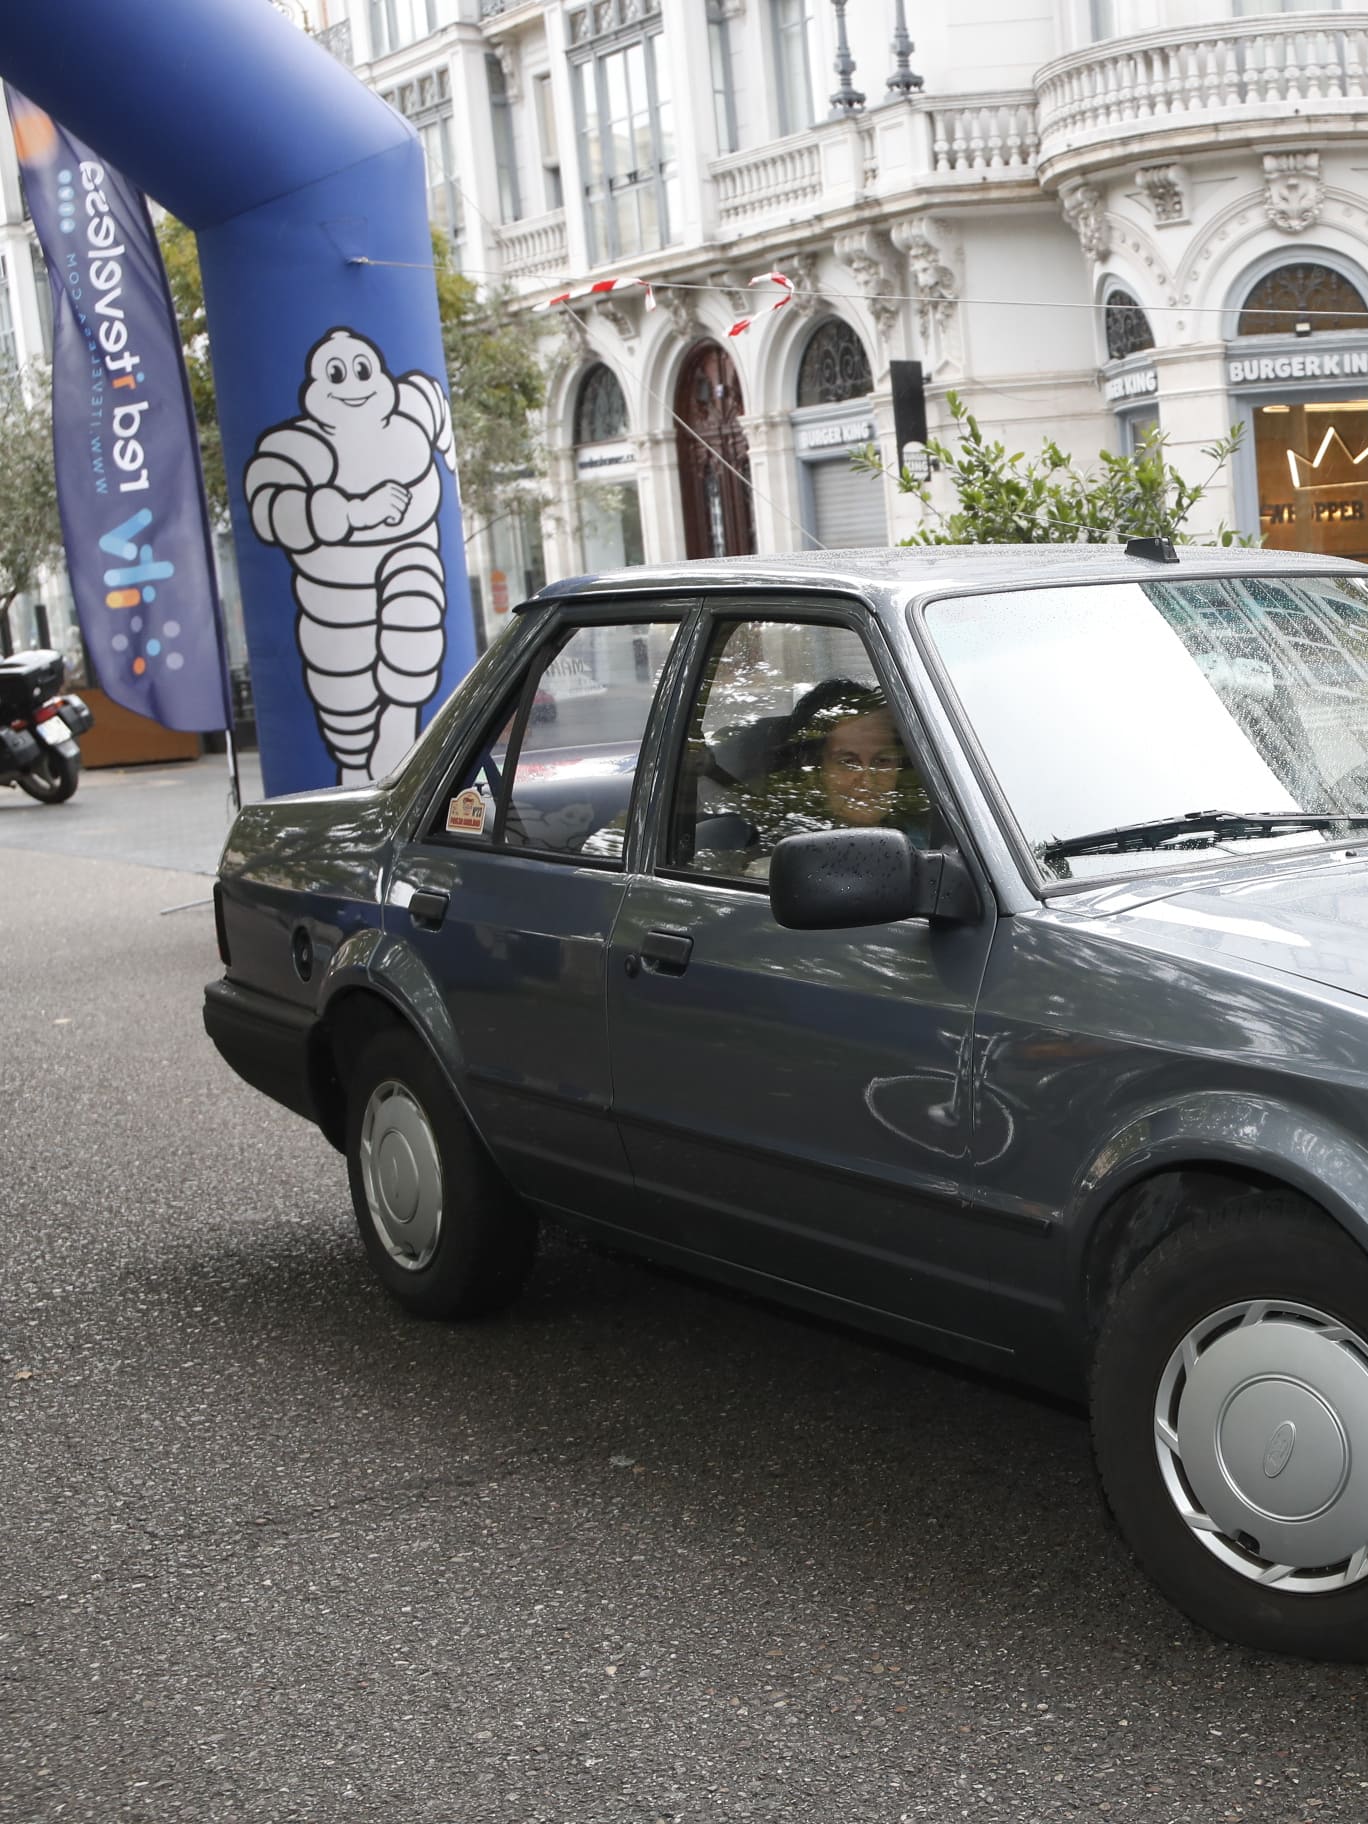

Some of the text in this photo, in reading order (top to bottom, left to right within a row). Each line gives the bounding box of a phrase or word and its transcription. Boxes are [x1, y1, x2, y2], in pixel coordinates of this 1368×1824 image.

[1124, 369, 1158, 396] KING
[1229, 359, 1320, 382] BURGER
[798, 421, 871, 449] BURGER KING
[1269, 500, 1364, 524] WHPPER
